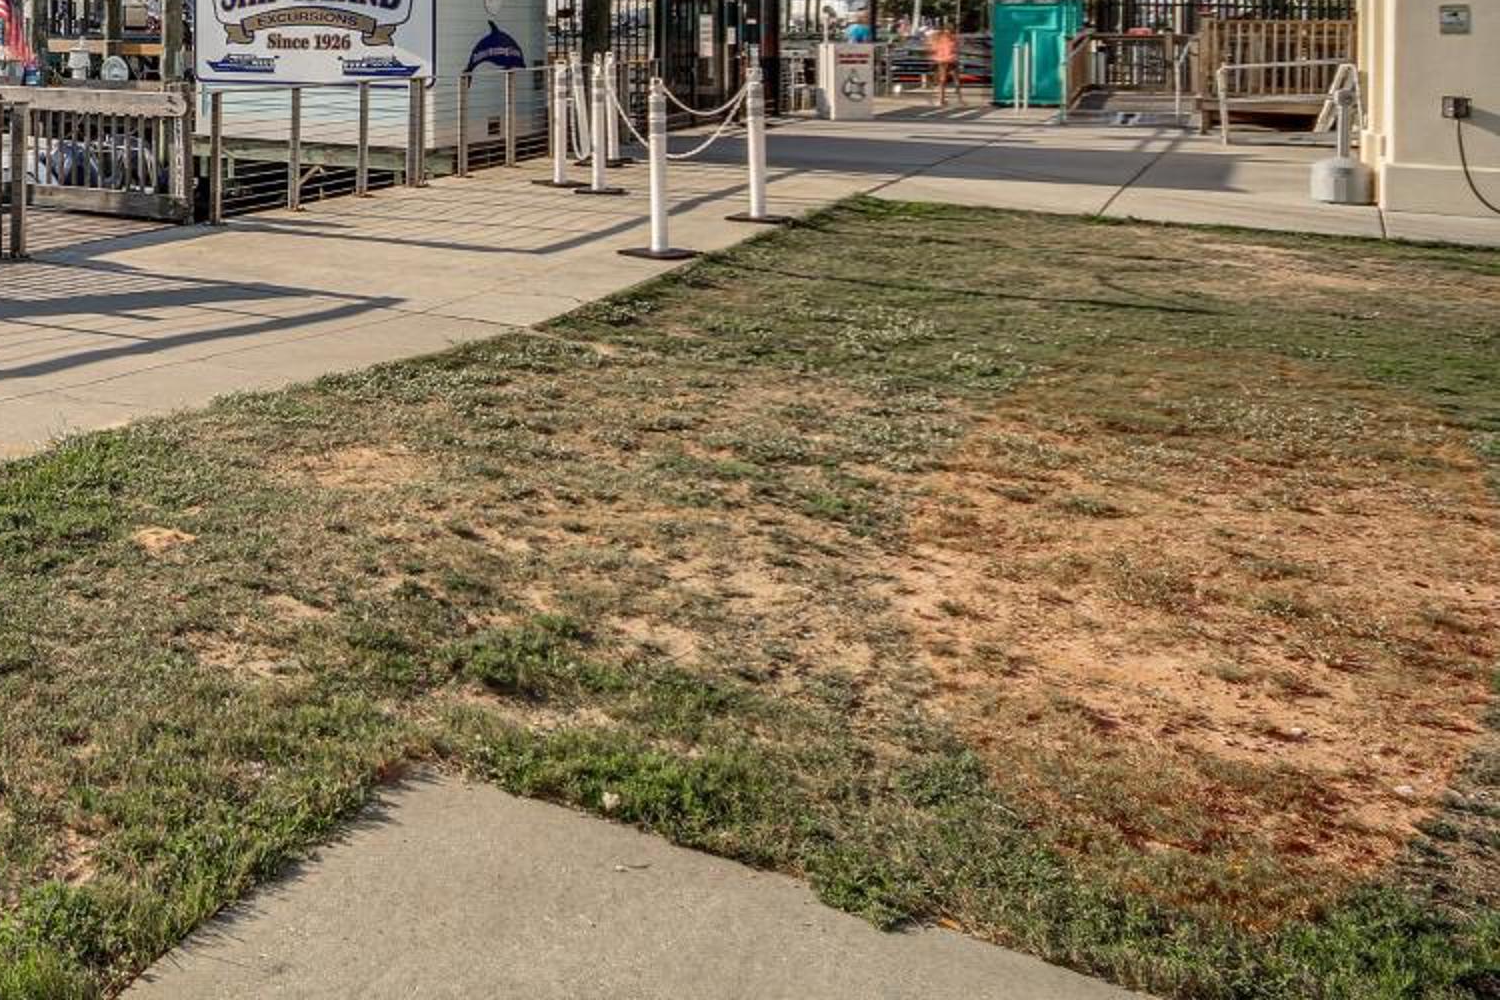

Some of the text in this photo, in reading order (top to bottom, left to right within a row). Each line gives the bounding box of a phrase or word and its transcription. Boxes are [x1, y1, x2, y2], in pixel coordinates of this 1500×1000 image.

[257, 10, 358, 27] EXCURSIONS
[267, 33, 351, 50] Since 1926
